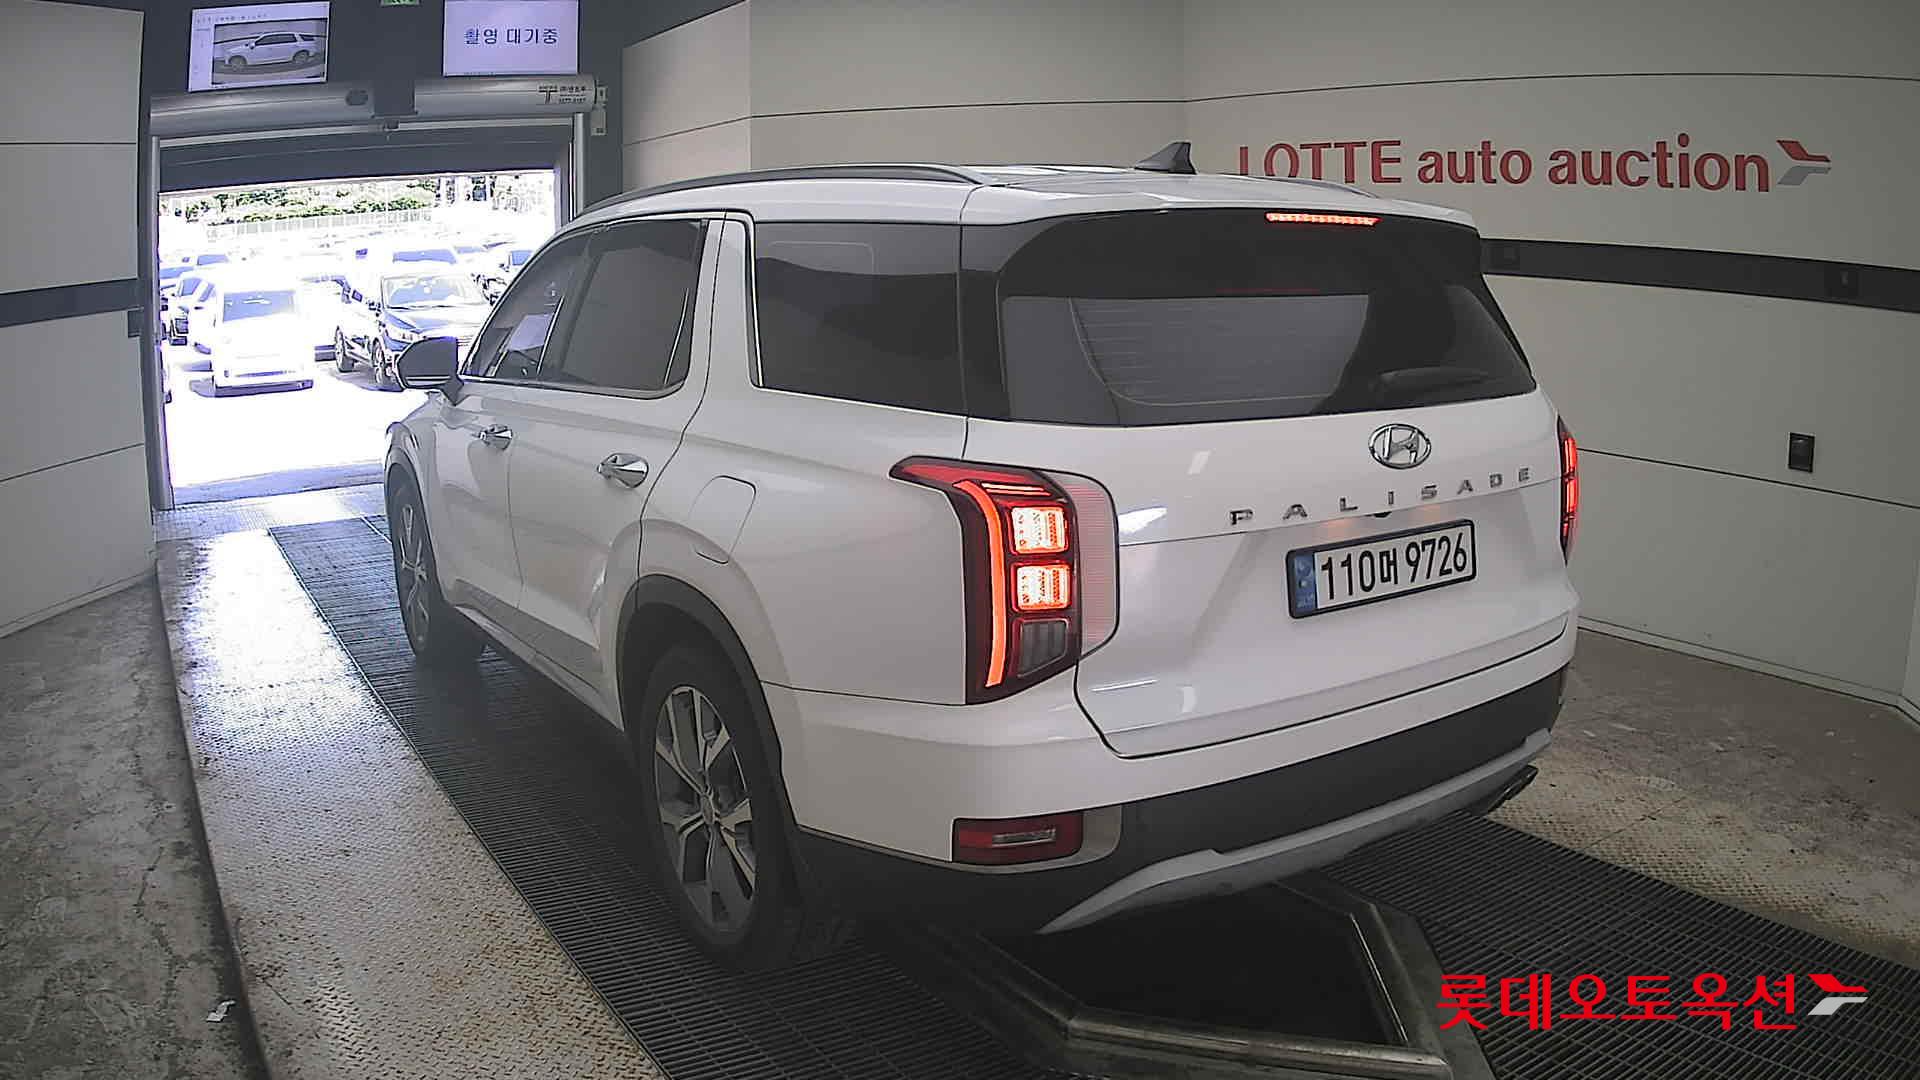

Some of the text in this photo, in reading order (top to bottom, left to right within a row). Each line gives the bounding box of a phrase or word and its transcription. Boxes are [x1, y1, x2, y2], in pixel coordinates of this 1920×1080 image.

[507, 28, 558, 44] 대기중
[1418, 141, 1533, 185] auto
[1549, 132, 1769, 192] auction
[1229, 467, 1531, 525] PALISADE
[1405, 532, 1467, 583] 9726
